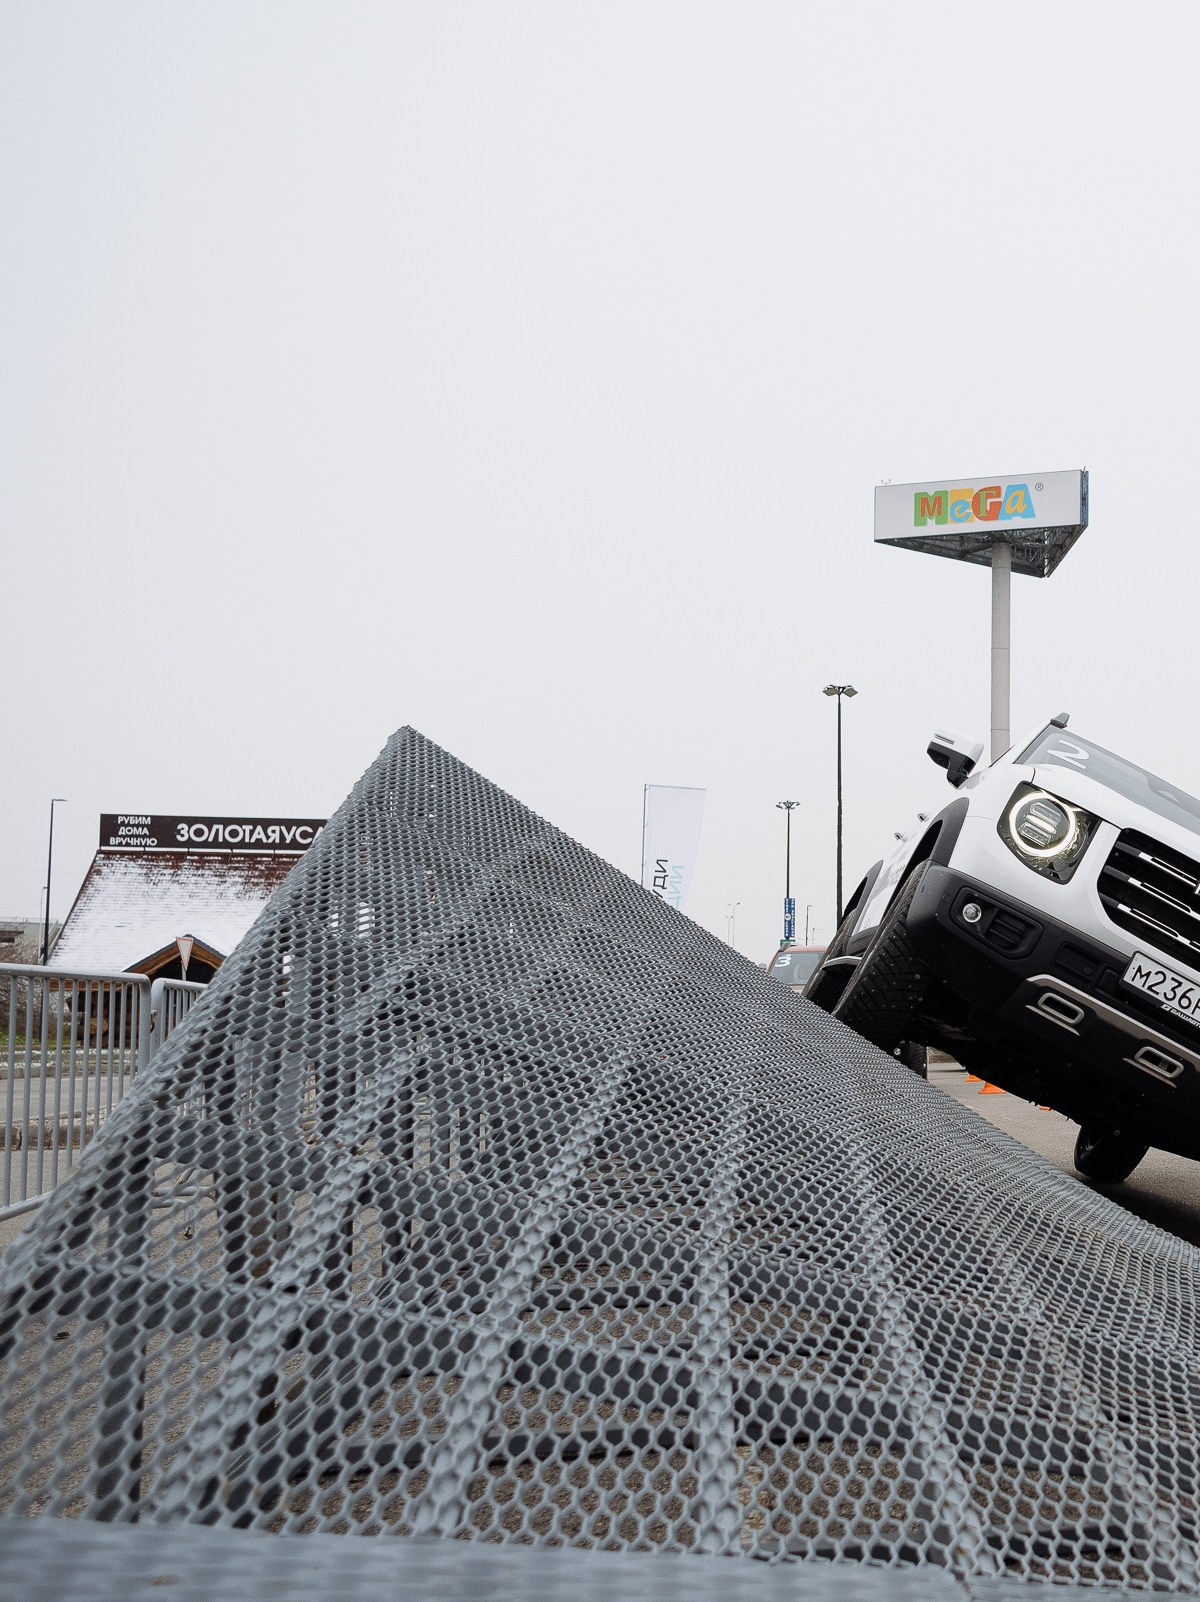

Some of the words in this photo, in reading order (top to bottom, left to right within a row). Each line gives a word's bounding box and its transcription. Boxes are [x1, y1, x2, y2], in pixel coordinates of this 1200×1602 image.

[1047, 739, 1090, 770] 2
[117, 815, 151, 825] РУБИМ
[118, 826, 149, 836] ДОМА
[109, 836, 158, 846] ВРУЧНУЮ
